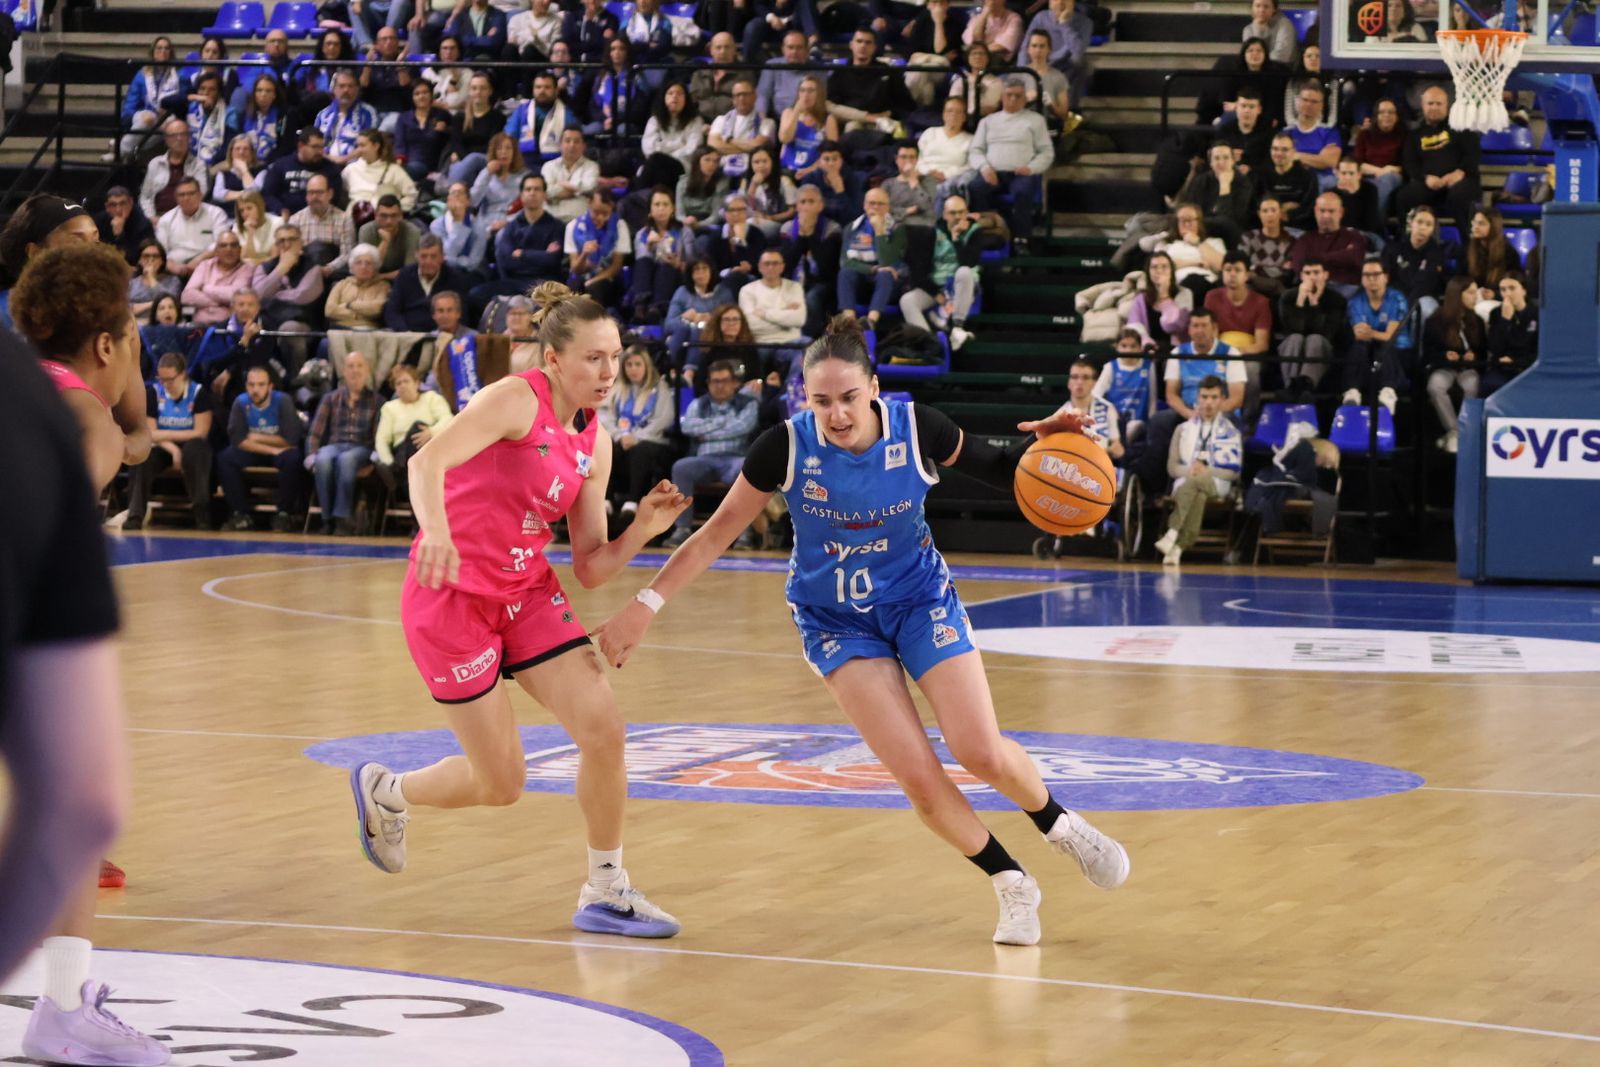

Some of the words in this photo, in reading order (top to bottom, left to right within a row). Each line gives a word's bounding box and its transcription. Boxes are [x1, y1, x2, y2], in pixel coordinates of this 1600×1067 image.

[1039, 455, 1102, 496] Wilson
[802, 503, 861, 521] CASTILLA
[868, 509, 877, 520] Y
[882, 499, 912, 517] LEÓN
[833, 567, 874, 604] 10
[457, 654, 495, 681] Diario
